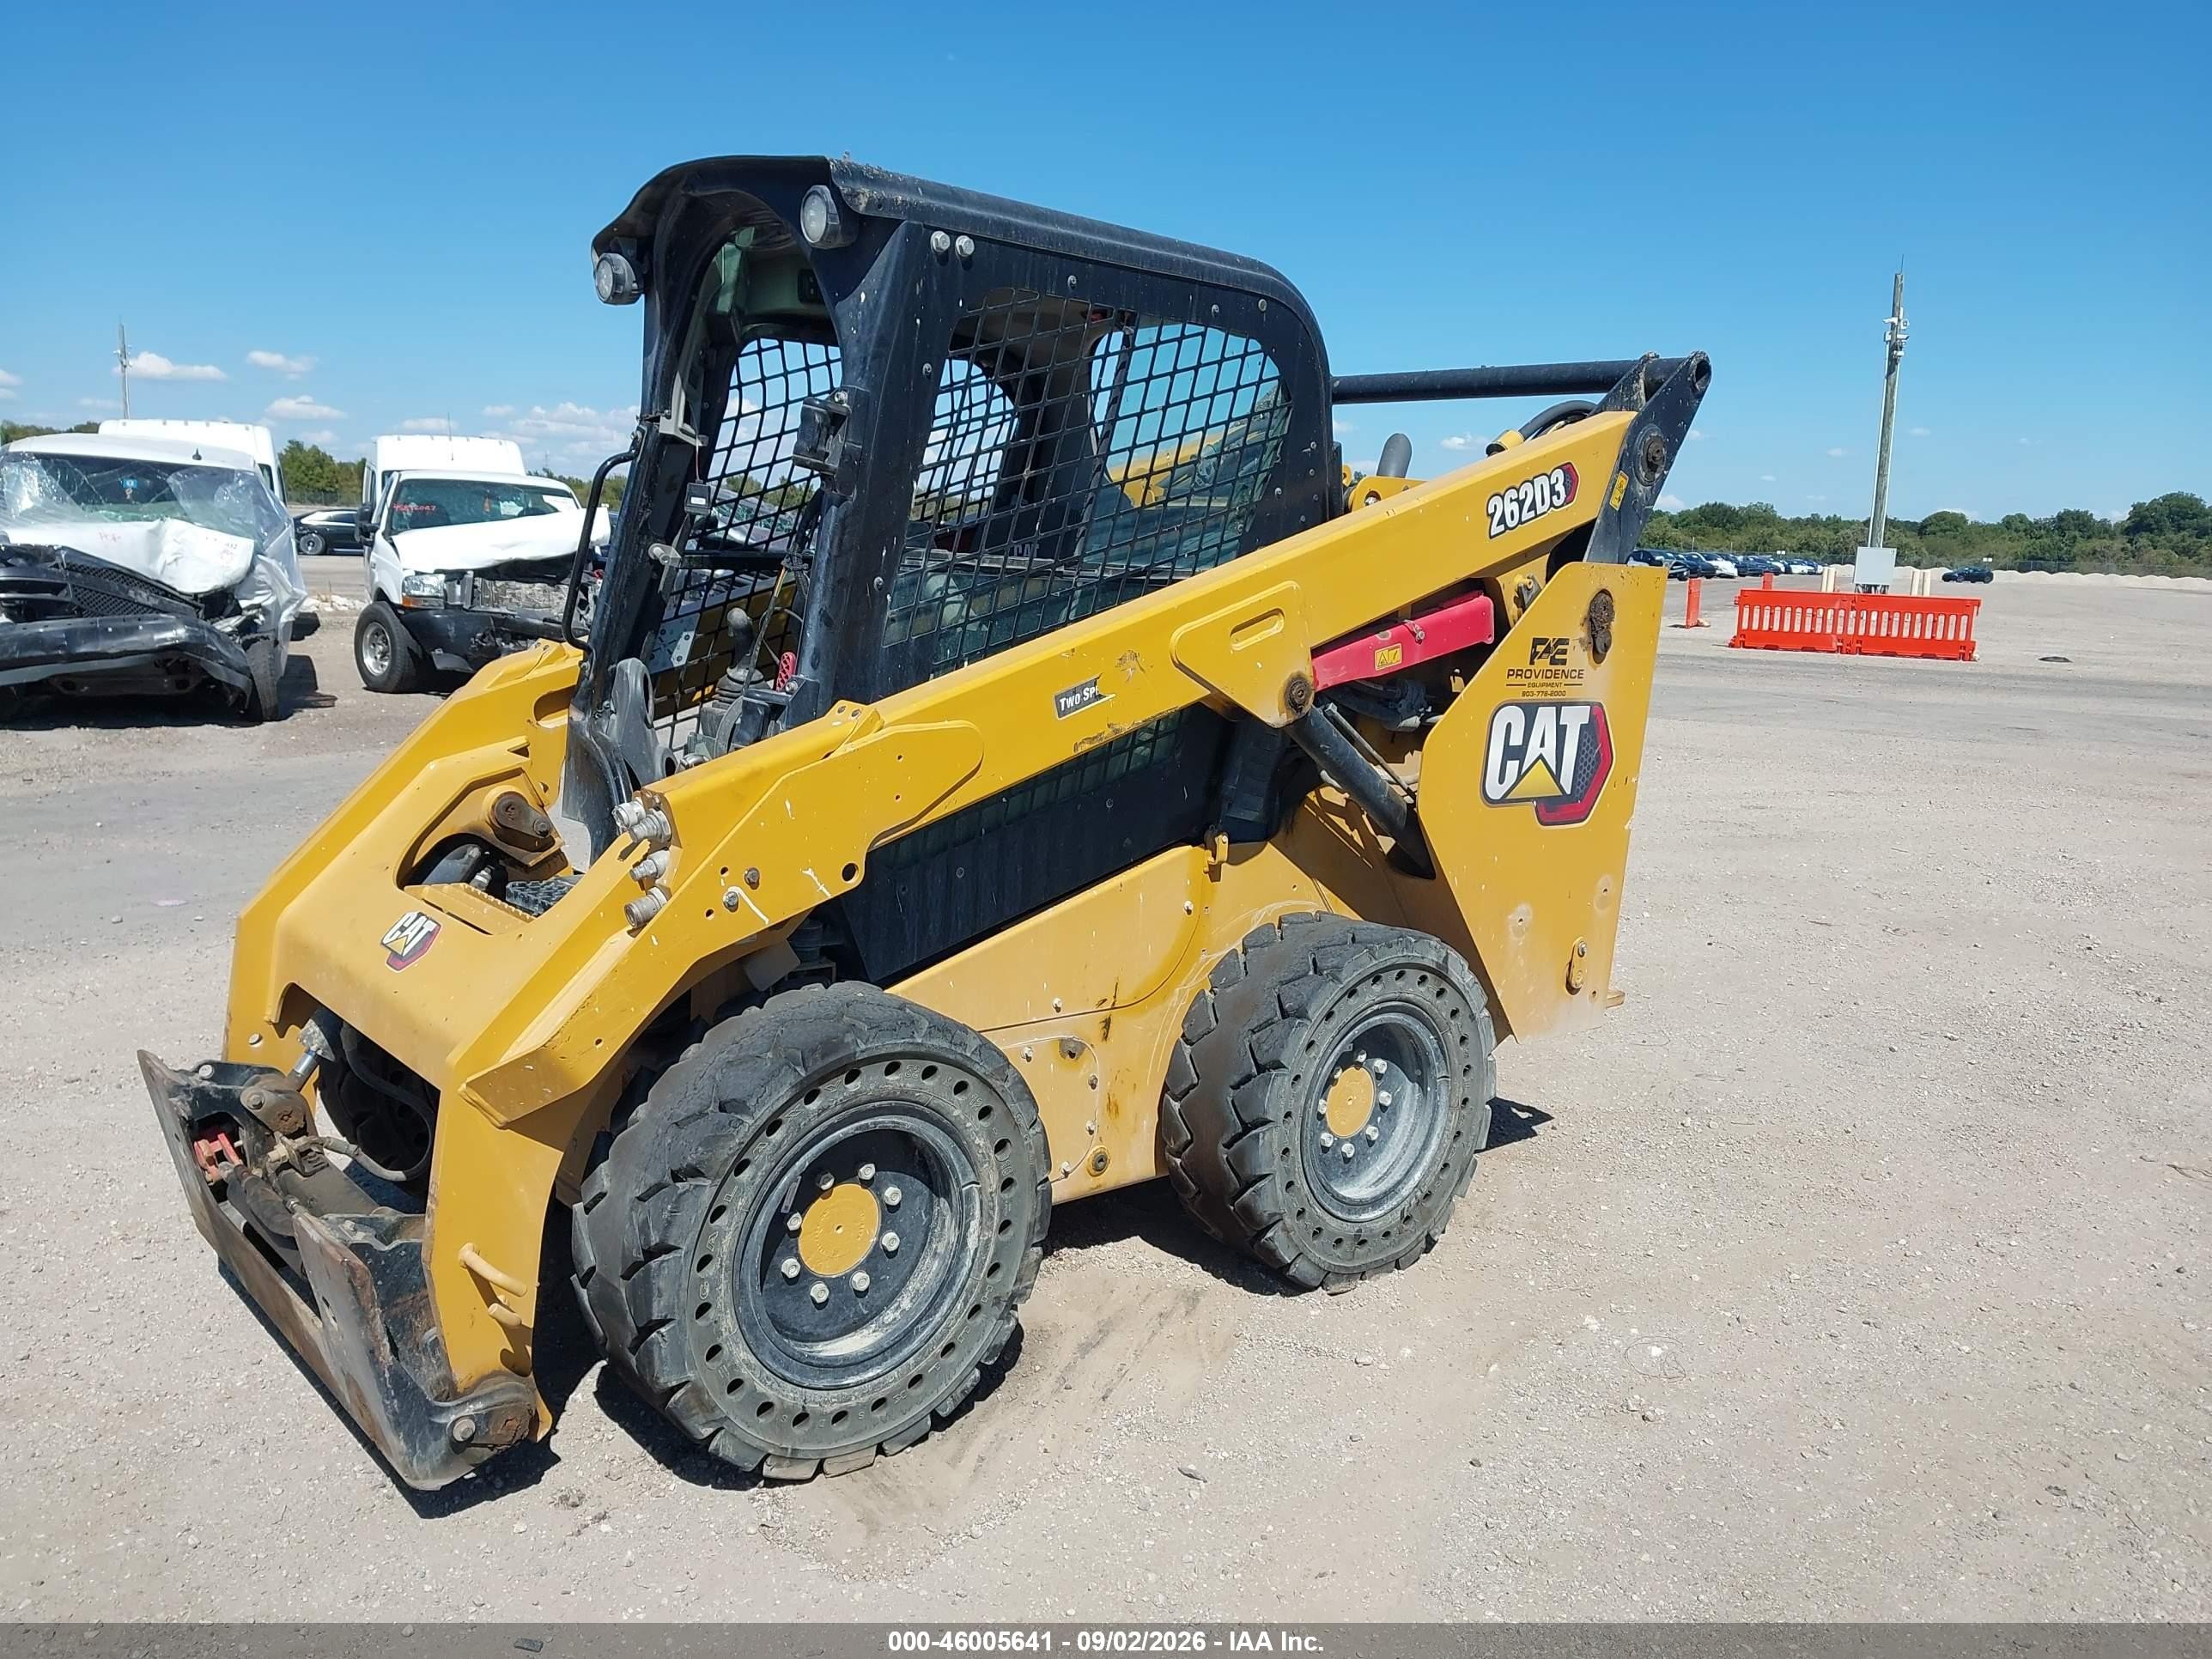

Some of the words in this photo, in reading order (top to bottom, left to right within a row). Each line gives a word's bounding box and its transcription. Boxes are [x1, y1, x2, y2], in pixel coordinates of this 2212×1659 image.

[1487, 468, 1567, 537] 262D3
[1507, 669, 1584, 679] PROVIDENCE
[1486, 705, 1591, 799] CAT
[382, 912, 438, 957] CAT
